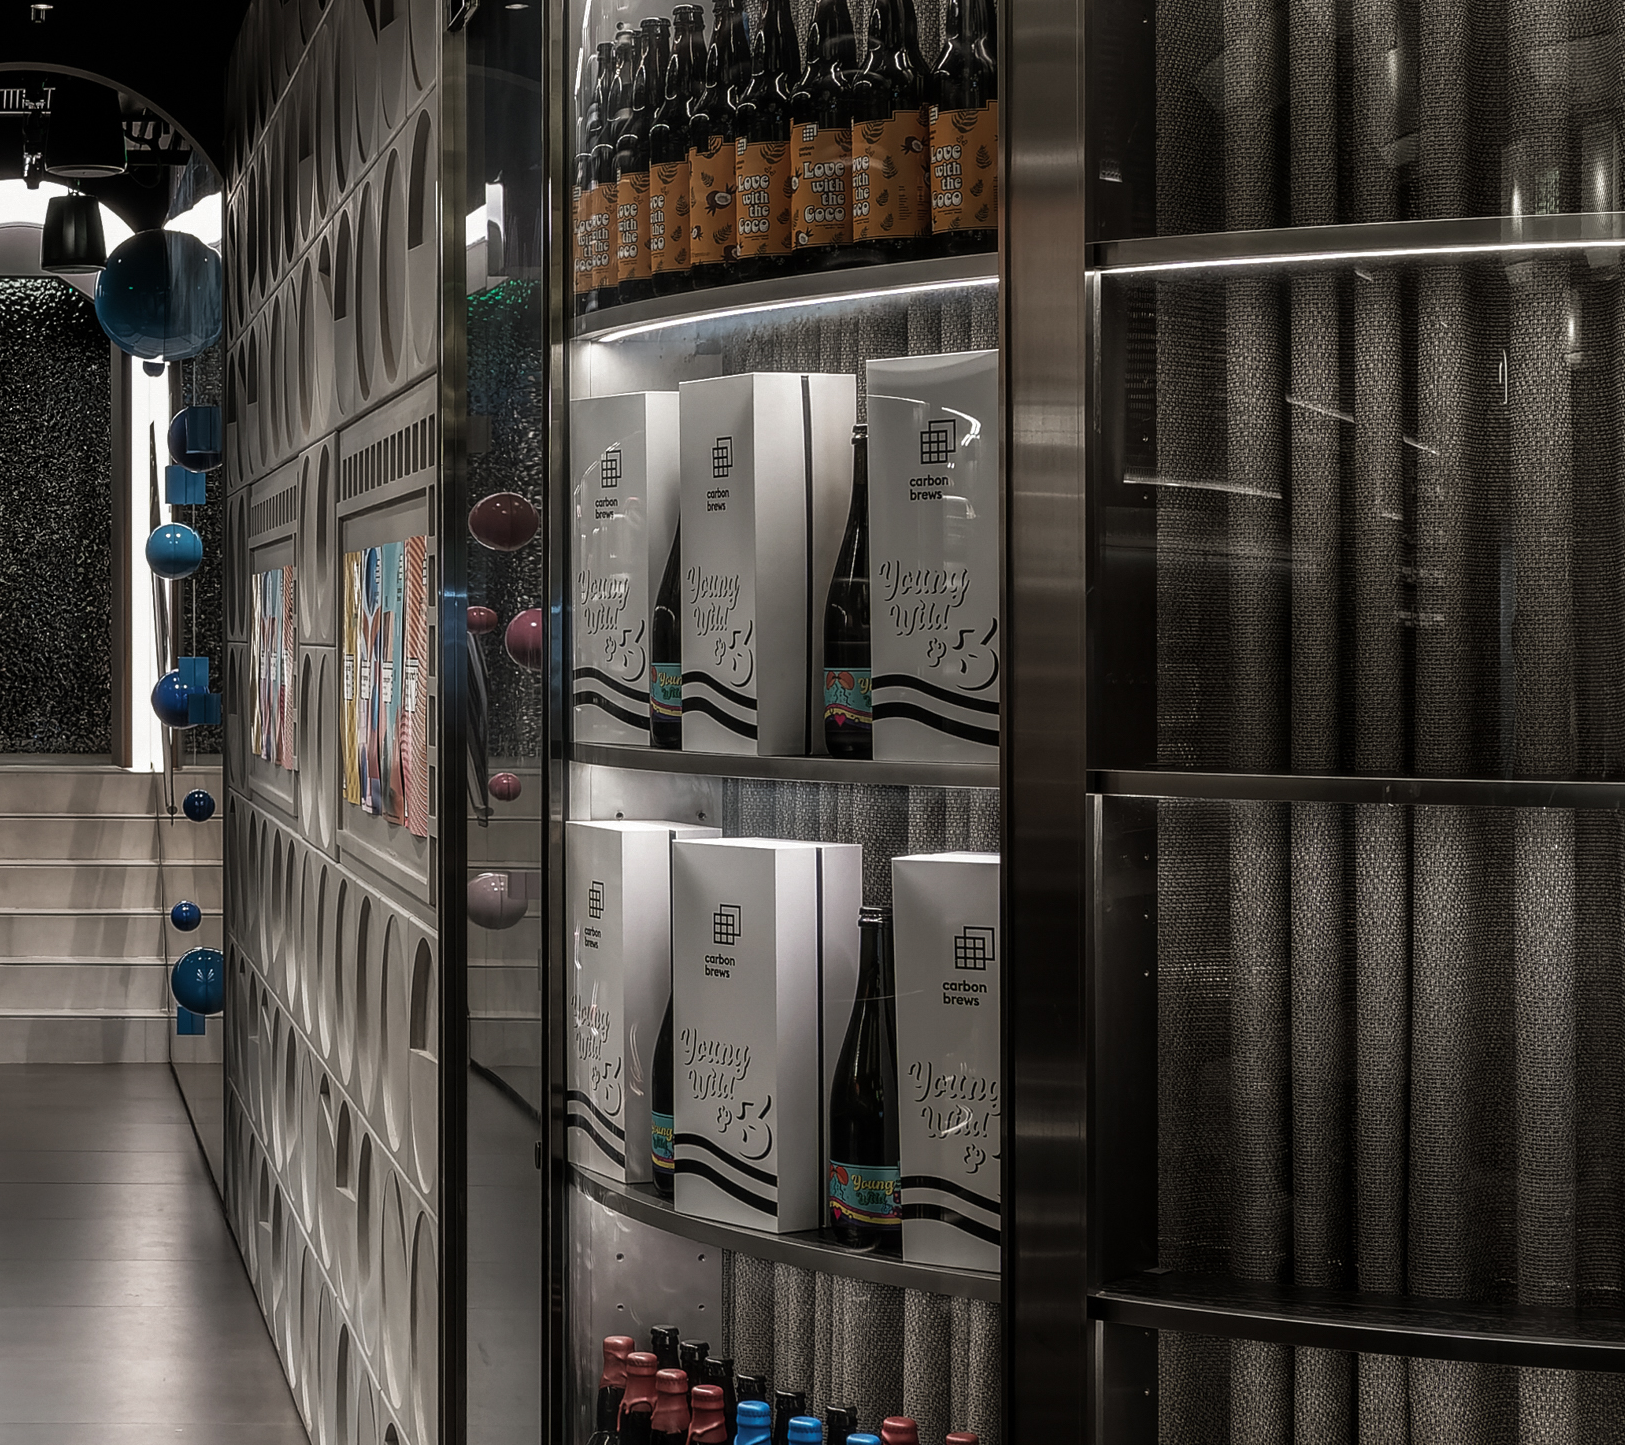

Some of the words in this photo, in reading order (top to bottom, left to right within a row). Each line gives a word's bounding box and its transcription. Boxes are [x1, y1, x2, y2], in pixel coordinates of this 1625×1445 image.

[931, 144, 962, 164] Love
[803, 161, 845, 179] Love
[934, 161, 962, 178] with
[738, 174, 770, 192] Love
[811, 178, 845, 193] with
[941, 177, 962, 190] the
[742, 190, 770, 205] with
[821, 192, 845, 206] the
[855, 187, 870, 201] the
[931, 191, 963, 209] Coco
[748, 205, 770, 217] the
[804, 205, 845, 223] Coco
[652, 223, 665, 236] the
[738, 218, 770, 235] Coco
[622, 232, 638, 244] the
[909, 475, 949, 487] carbon
[707, 488, 729, 499] carbon
[910, 489, 942, 501] brews
[595, 497, 618, 508] carbon
[707, 501, 726, 512] brews
[595, 509, 614, 519] brews
[578, 570, 630, 610] Young
[687, 566, 740, 610] Young
[879, 560, 970, 607] Young
[584, 603, 618, 635] Wild
[693, 602, 729, 636] Wild
[889, 600, 950, 636] Wild
[584, 926, 601, 938] carbon
[584, 937, 599, 949] brews
[705, 954, 735, 966] carbon
[705, 965, 730, 978] brews
[942, 980, 987, 993] carbon
[943, 993, 979, 1006] brews
[680, 1028, 751, 1080] Young
[688, 1068, 736, 1100] Wild
[921, 1105, 990, 1138] Wild
[851, 1175, 895, 1196] Young
